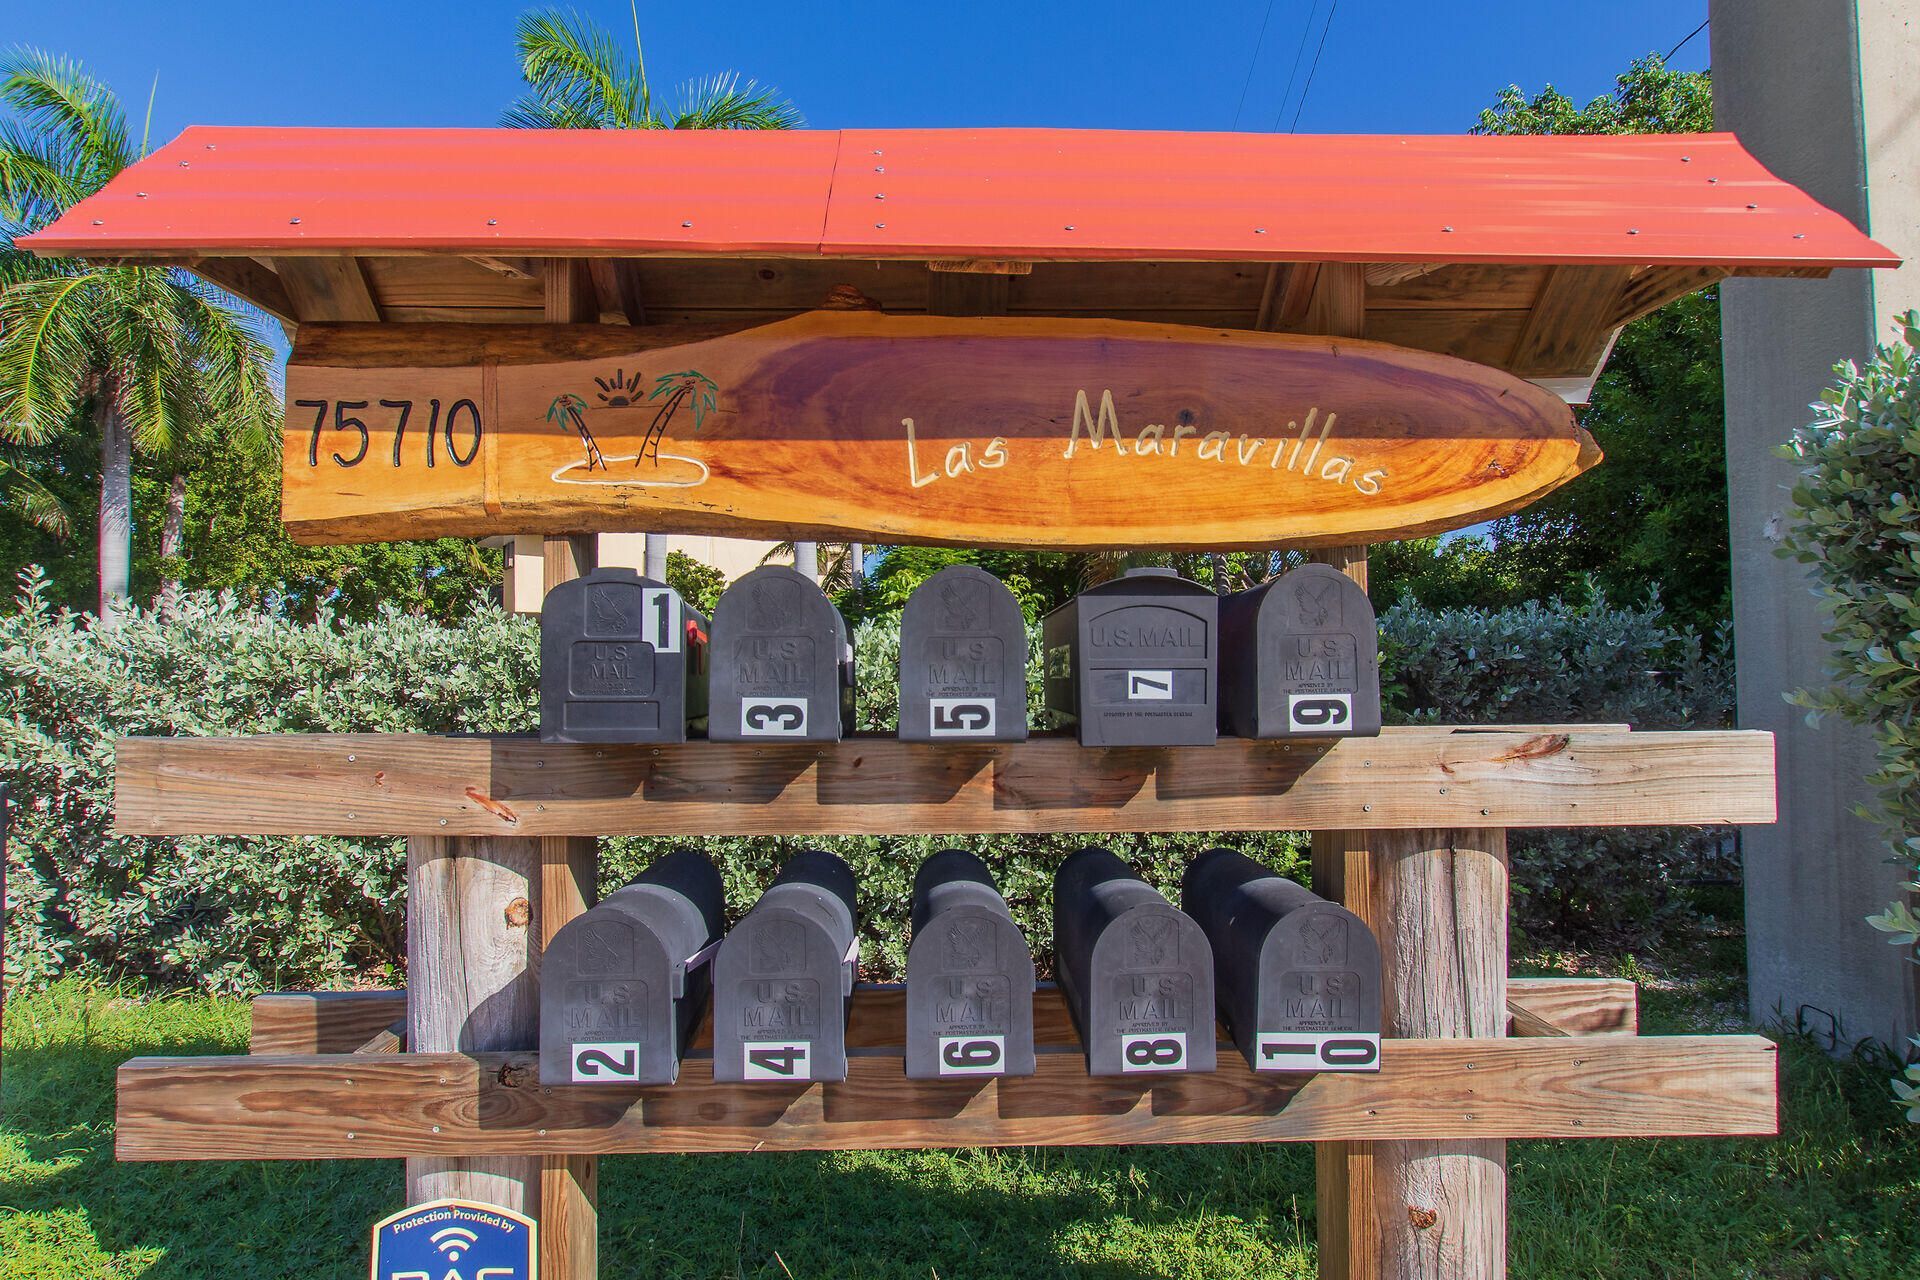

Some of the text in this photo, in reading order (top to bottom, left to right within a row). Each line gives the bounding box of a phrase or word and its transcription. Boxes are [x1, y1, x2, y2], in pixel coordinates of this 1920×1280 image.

[295, 399, 483, 468] 75710
[901, 389, 1389, 496] Las Maravillas
[653, 593, 669, 649] 1
[1091, 626, 1204, 648] U.S. MAIL
[594, 644, 633, 661] U.S.
[591, 663, 637, 680] MAIL
[739, 662, 808, 684] MAIL
[929, 662, 997, 684] MAIL
[1285, 659, 1351, 681] MAIL
[1132, 676, 1169, 694] 7
[746, 704, 804, 730] 3
[934, 704, 991, 730] 5
[1292, 699, 1349, 725] 9
[571, 1006, 641, 1029] MAIL
[743, 1004, 816, 1027] MAIL
[936, 1001, 1002, 1023] MAIL
[1119, 998, 1185, 1020] MAIL
[1286, 998, 1353, 1018] MAIL
[576, 1049, 635, 1076] 2
[749, 1047, 806, 1075] 4
[943, 1041, 1001, 1067] 6
[1126, 1039, 1182, 1065] 8
[1262, 1040, 1377, 1065] 10
[393, 1209, 516, 1234] Protection Provided by
